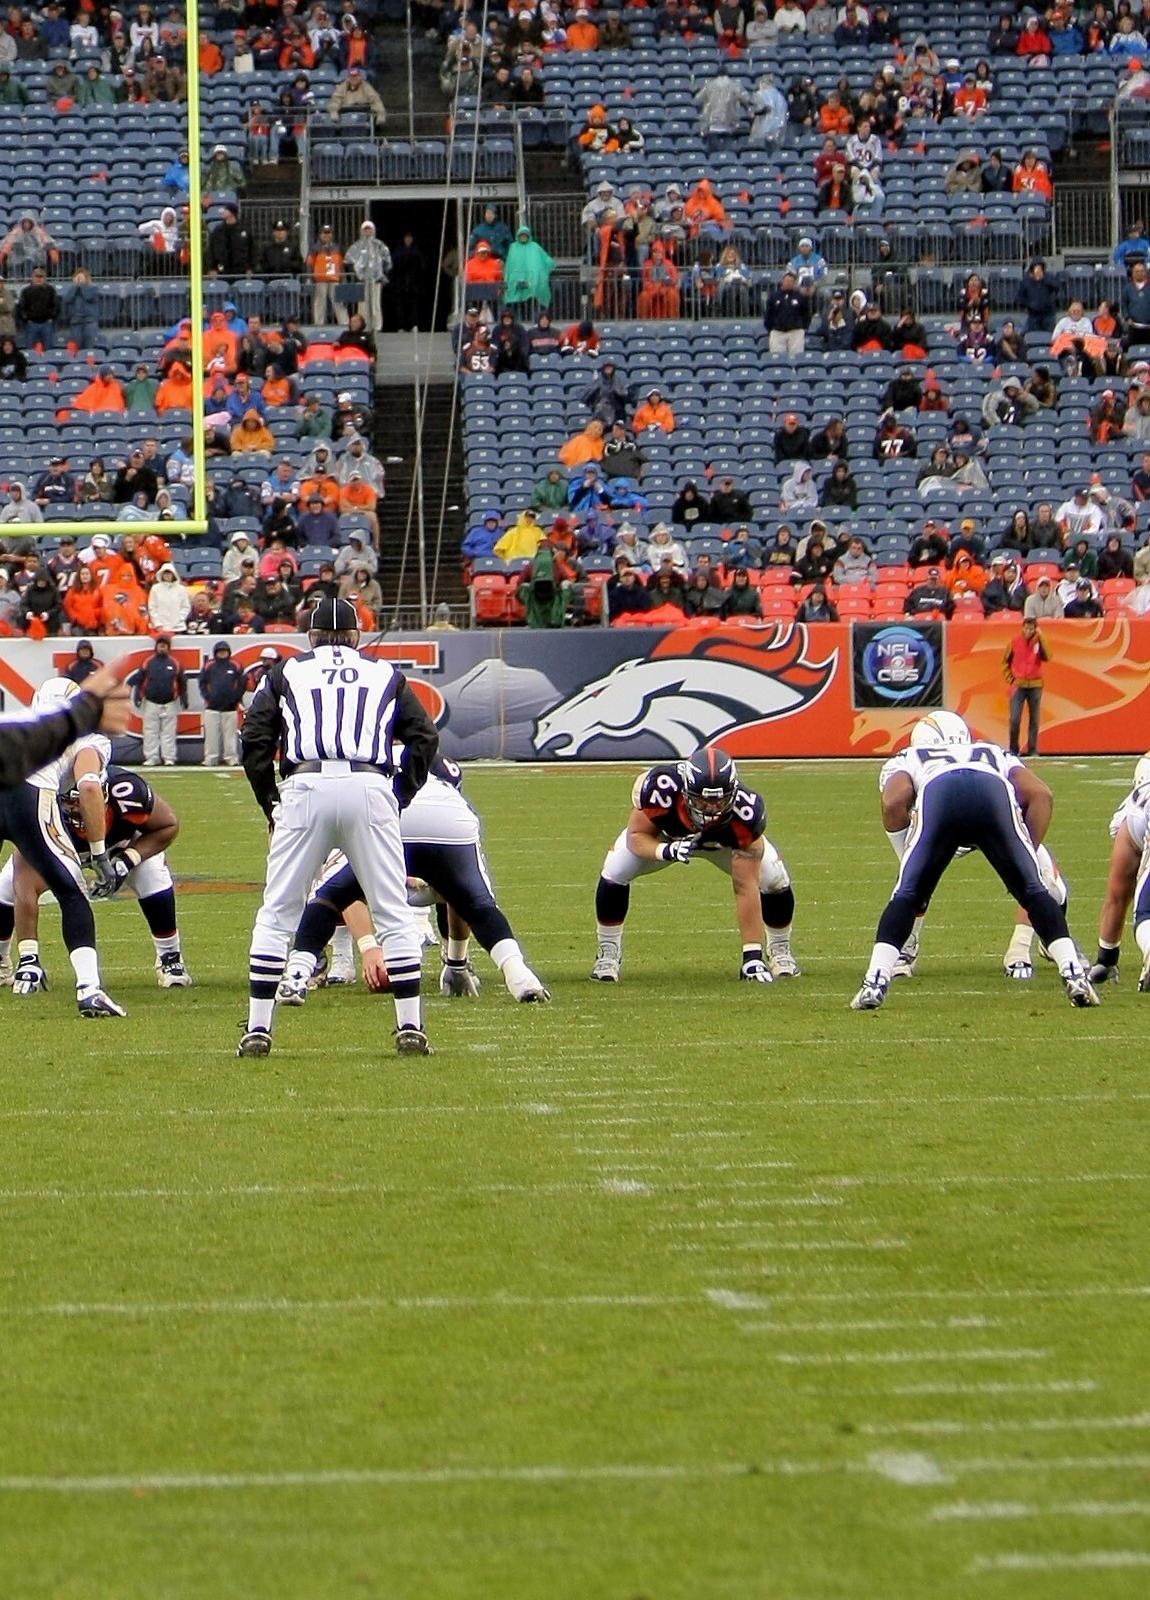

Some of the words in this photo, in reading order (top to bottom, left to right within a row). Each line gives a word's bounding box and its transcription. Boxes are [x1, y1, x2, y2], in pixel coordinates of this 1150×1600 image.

[471, 356, 490, 370] 53
[881, 439, 904, 454] 77
[877, 644, 919, 657] NFL
[321, 667, 359, 685] 70
[877, 668, 919, 682] CBS
[111, 781, 144, 813] 70
[649, 774, 679, 808] 62
[733, 789, 757, 822] 62
